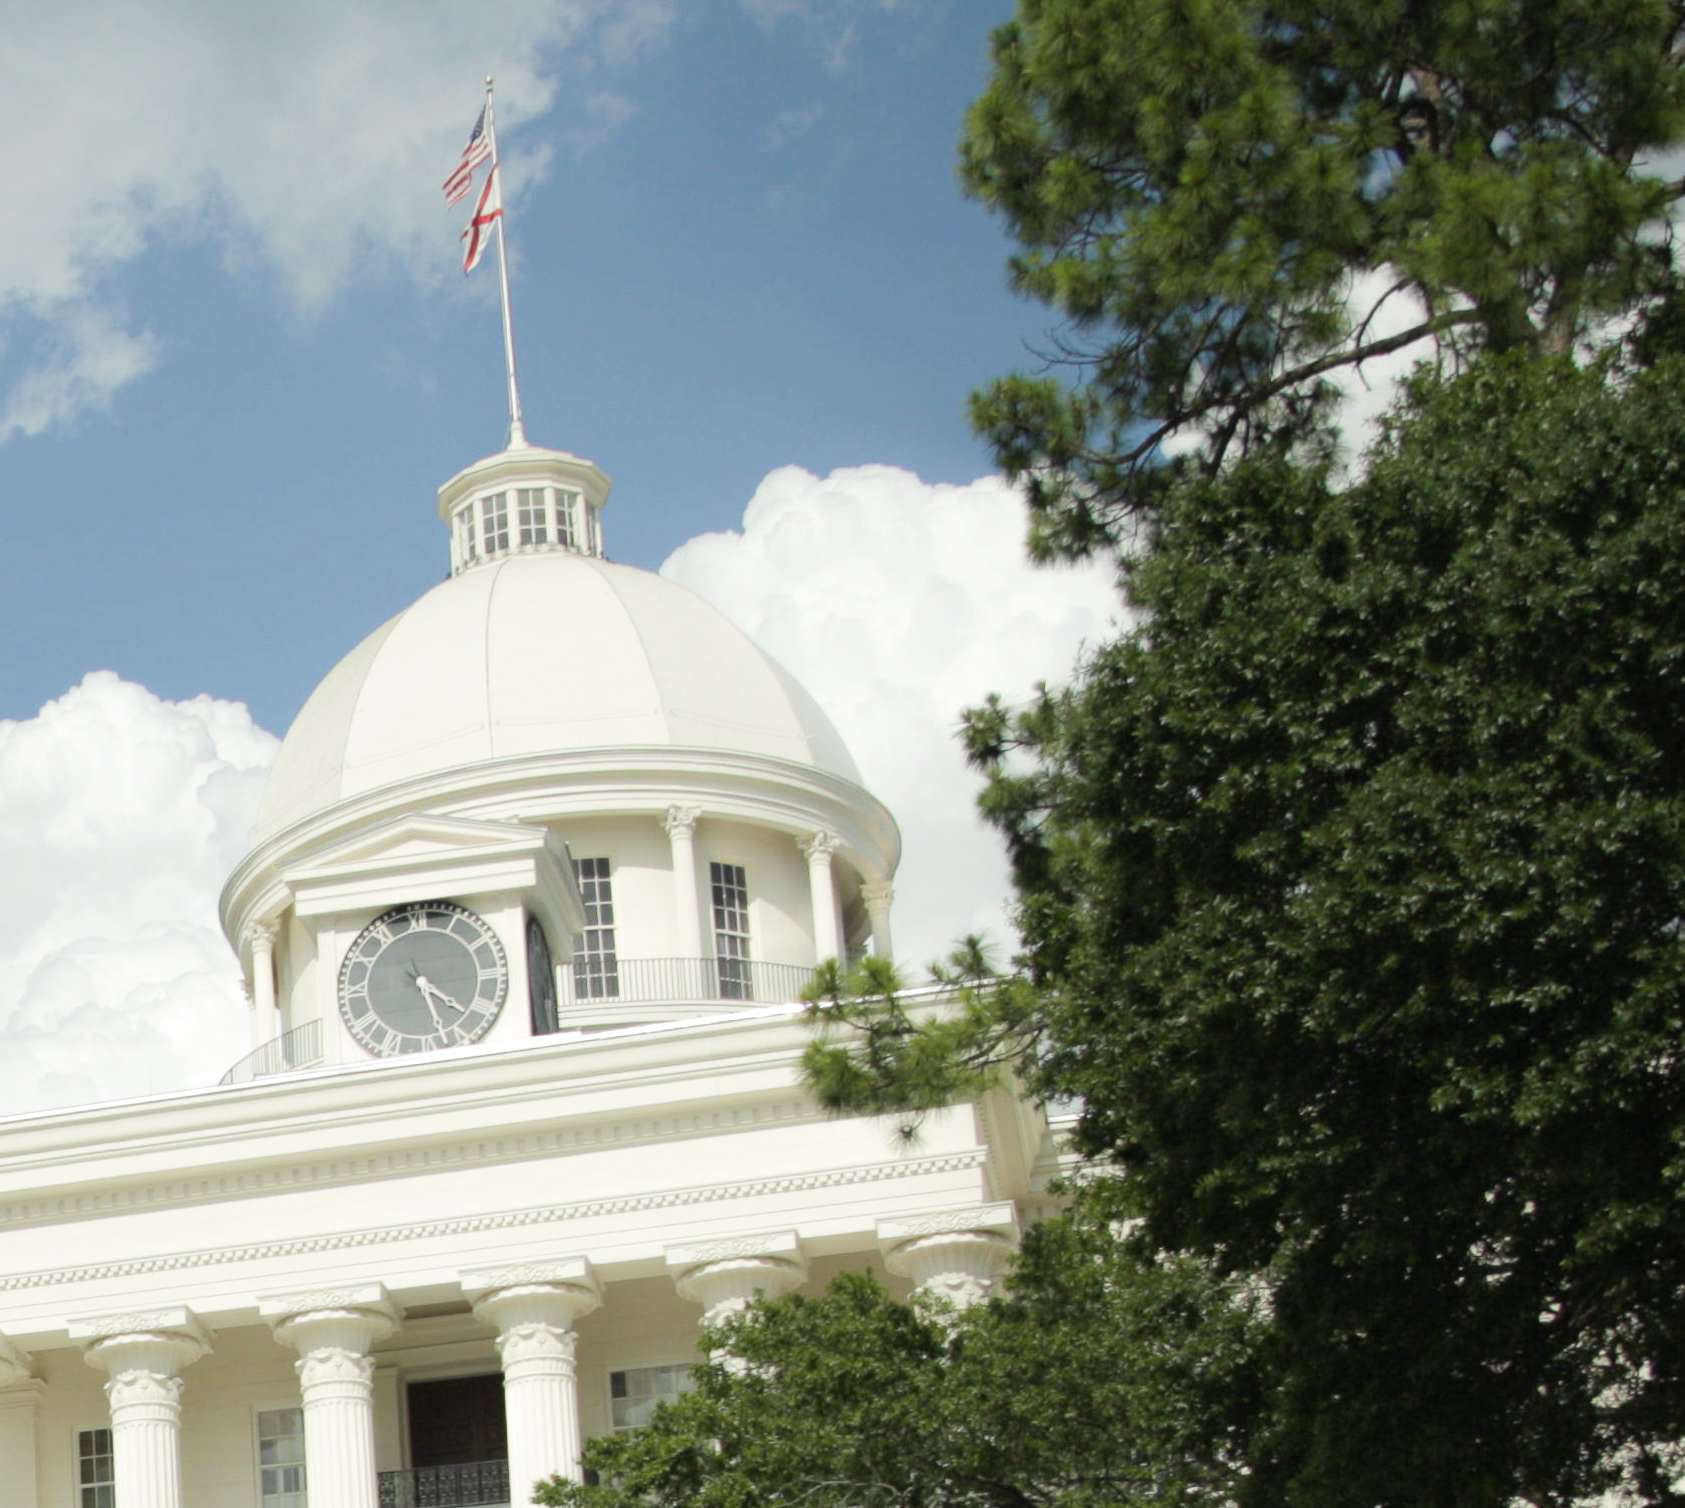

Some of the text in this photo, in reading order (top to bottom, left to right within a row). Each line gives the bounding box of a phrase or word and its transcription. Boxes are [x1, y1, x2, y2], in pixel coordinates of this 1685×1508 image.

[407, 910, 427, 932] XII
[446, 914, 458, 933] I
[371, 924, 395, 947] XI
[468, 936, 488, 951] II
[354, 952, 375, 967] X
[479, 968, 500, 979] III
[347, 982, 366, 998] IX
[353, 1011, 380, 1041] VIII
[382, 1029, 402, 1056] VII
